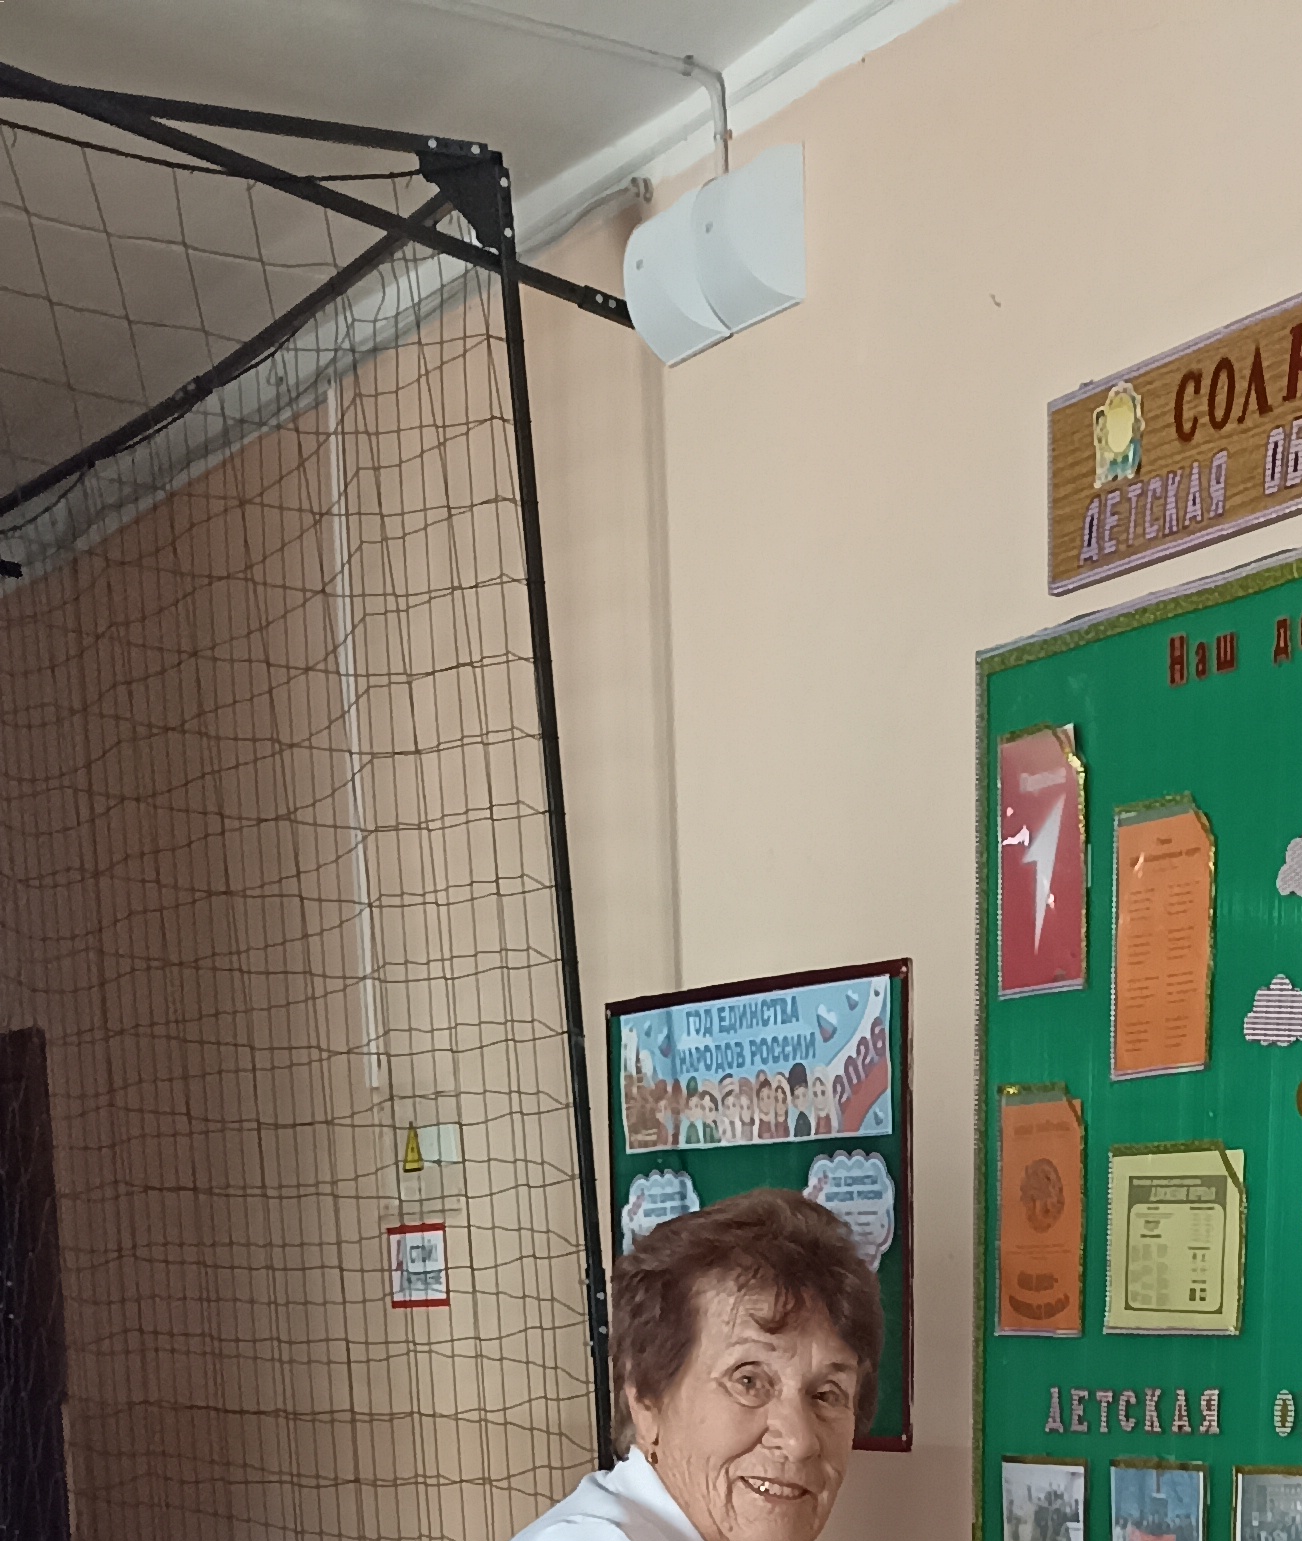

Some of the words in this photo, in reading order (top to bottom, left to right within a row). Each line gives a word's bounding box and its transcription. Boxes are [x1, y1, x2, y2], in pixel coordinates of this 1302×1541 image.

[1078, 450, 1228, 567] ДЕТСКАЯ
[1168, 631, 1238, 686] Наш
[685, 1008, 713, 1038] ГОД
[716, 995, 800, 1035] ЕДИНСТВА
[679, 1041, 746, 1075] НАРОДОВ
[749, 1032, 816, 1067] РОССИИ
[1044, 1386, 1221, 1435] ДЕТСКАЯ
